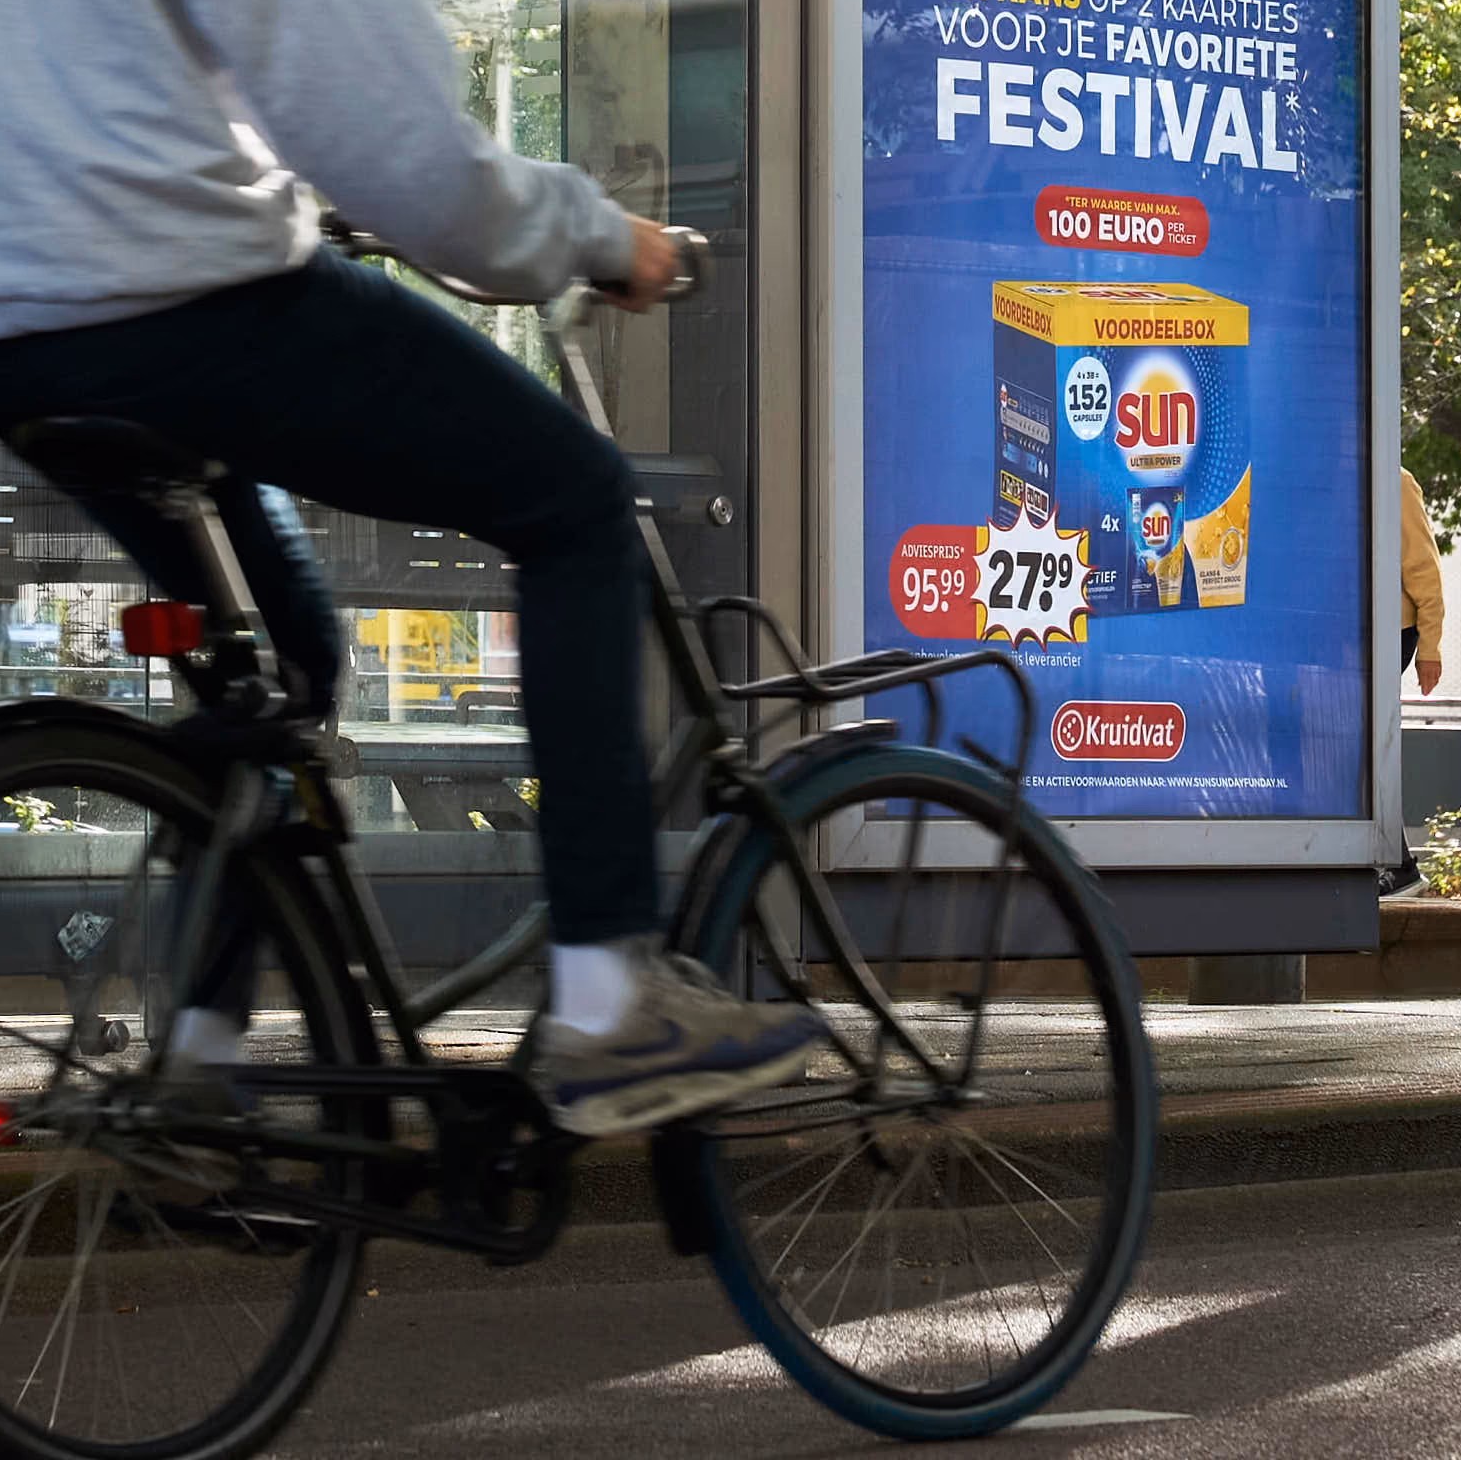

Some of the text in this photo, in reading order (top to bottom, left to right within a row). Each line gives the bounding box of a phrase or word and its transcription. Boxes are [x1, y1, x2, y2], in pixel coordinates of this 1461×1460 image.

[933, 5, 1297, 81] VOOR JE FAVORIETE
[1091, 198, 1132, 212] WAARDE
[1134, 202, 1154, 214] VAN
[1155, 204, 1180, 215] MAX.
[1048, 209, 1185, 245] 100 EURO PER
[1168, 233, 1196, 245] TICKET
[995, 293, 1052, 337] VOORDEELBOX
[1094, 318, 1216, 340] VOORDEELBOX
[1069, 384, 1107, 410] 152
[1073, 414, 1102, 422] CAPSULES
[1115, 391, 1196, 448] sun
[1131, 456, 1181, 467] ULTRA POWER
[1101, 514, 1119, 532] 4x
[1142, 516, 1170, 538] sun
[1025, 651, 1082, 668] leverancier
[1086, 714, 1175, 747] Kruidvat
[1032, 776, 1045, 787] EN
[1046, 776, 1139, 788] ACTIEVOORWAARDEN
